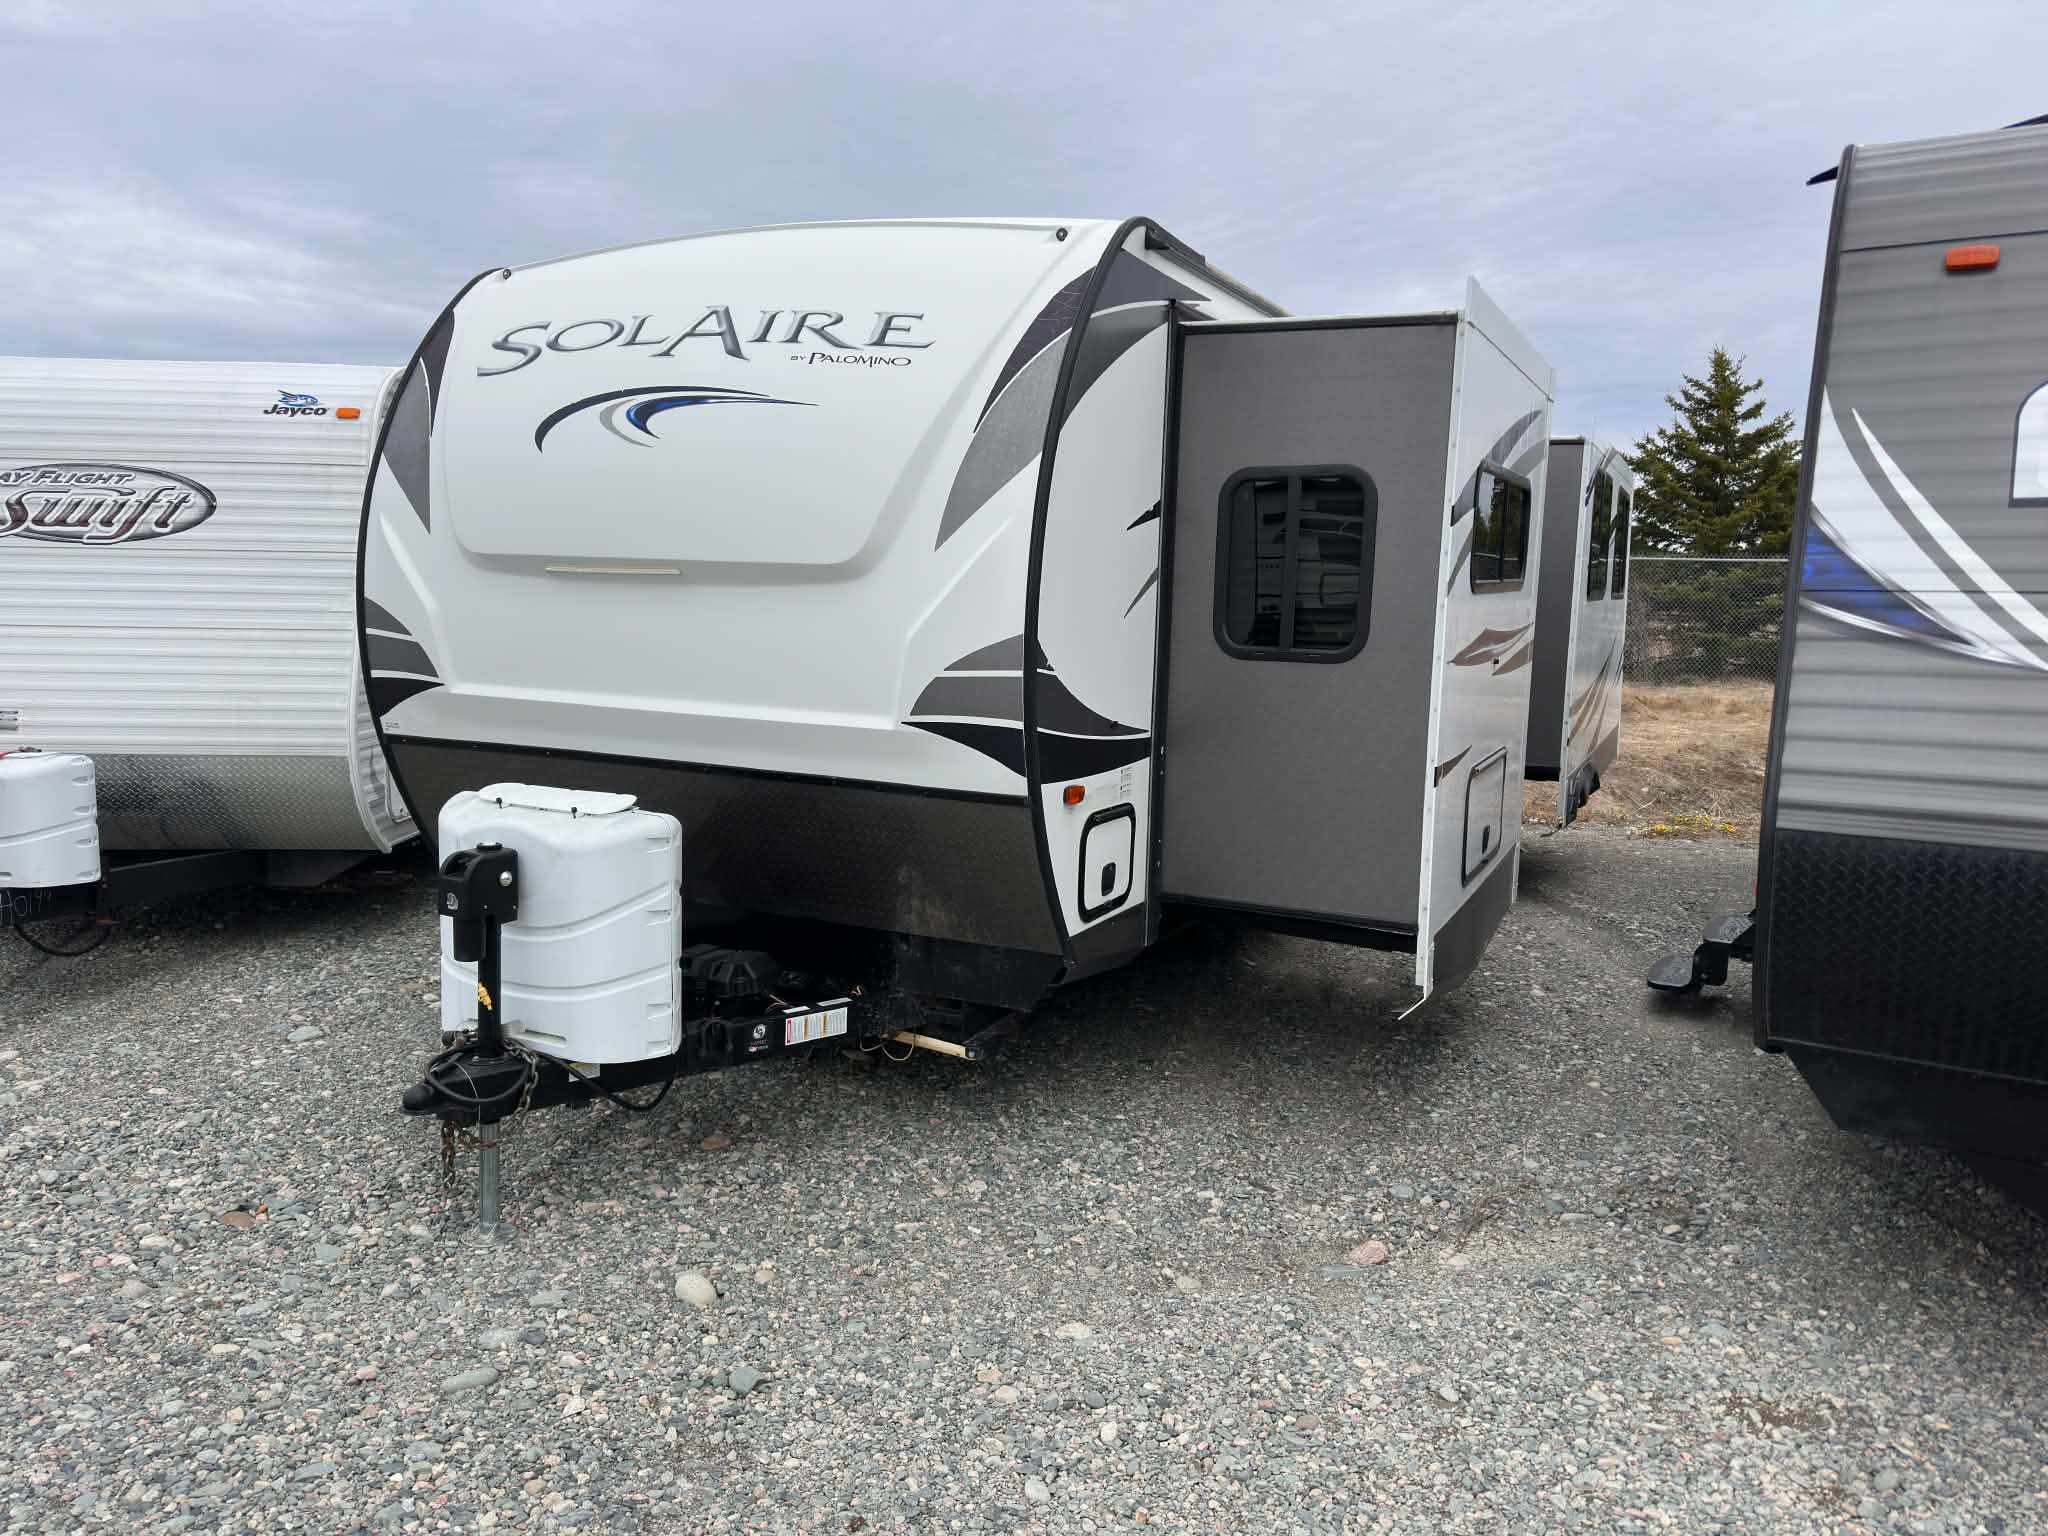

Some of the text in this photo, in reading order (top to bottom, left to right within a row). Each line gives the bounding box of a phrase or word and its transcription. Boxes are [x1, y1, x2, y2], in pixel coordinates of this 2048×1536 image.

[808, 352, 912, 368] PALOMINO
[263, 404, 328, 417] Jayco
[0, 471, 32, 484] AY
